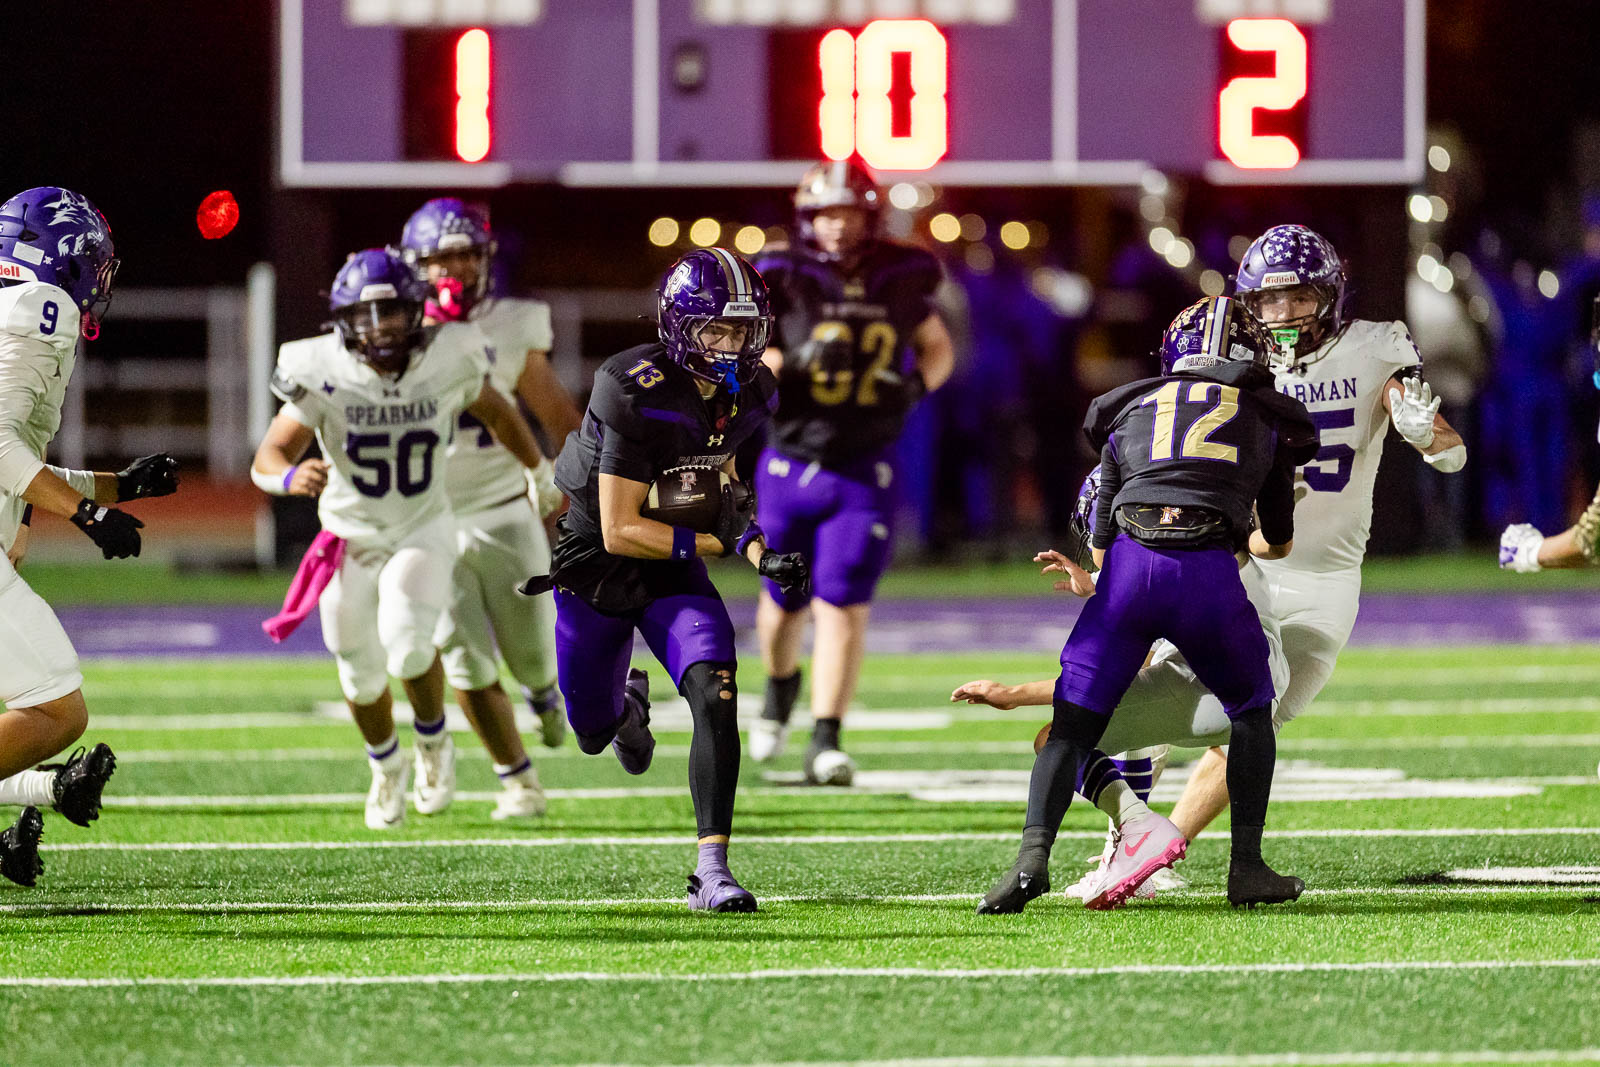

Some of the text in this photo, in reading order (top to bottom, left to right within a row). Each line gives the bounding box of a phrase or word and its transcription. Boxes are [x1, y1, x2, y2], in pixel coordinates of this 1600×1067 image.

[455, 28, 491, 162] 1
[819, 19, 948, 170] 10
[1219, 18, 1307, 169] 2
[1265, 274, 1296, 284] Riddell
[39, 300, 59, 335] 9
[624, 358, 665, 389] 13
[345, 400, 438, 427] SPEARMAN
[1140, 380, 1240, 464] 12
[346, 429, 440, 498] 50
